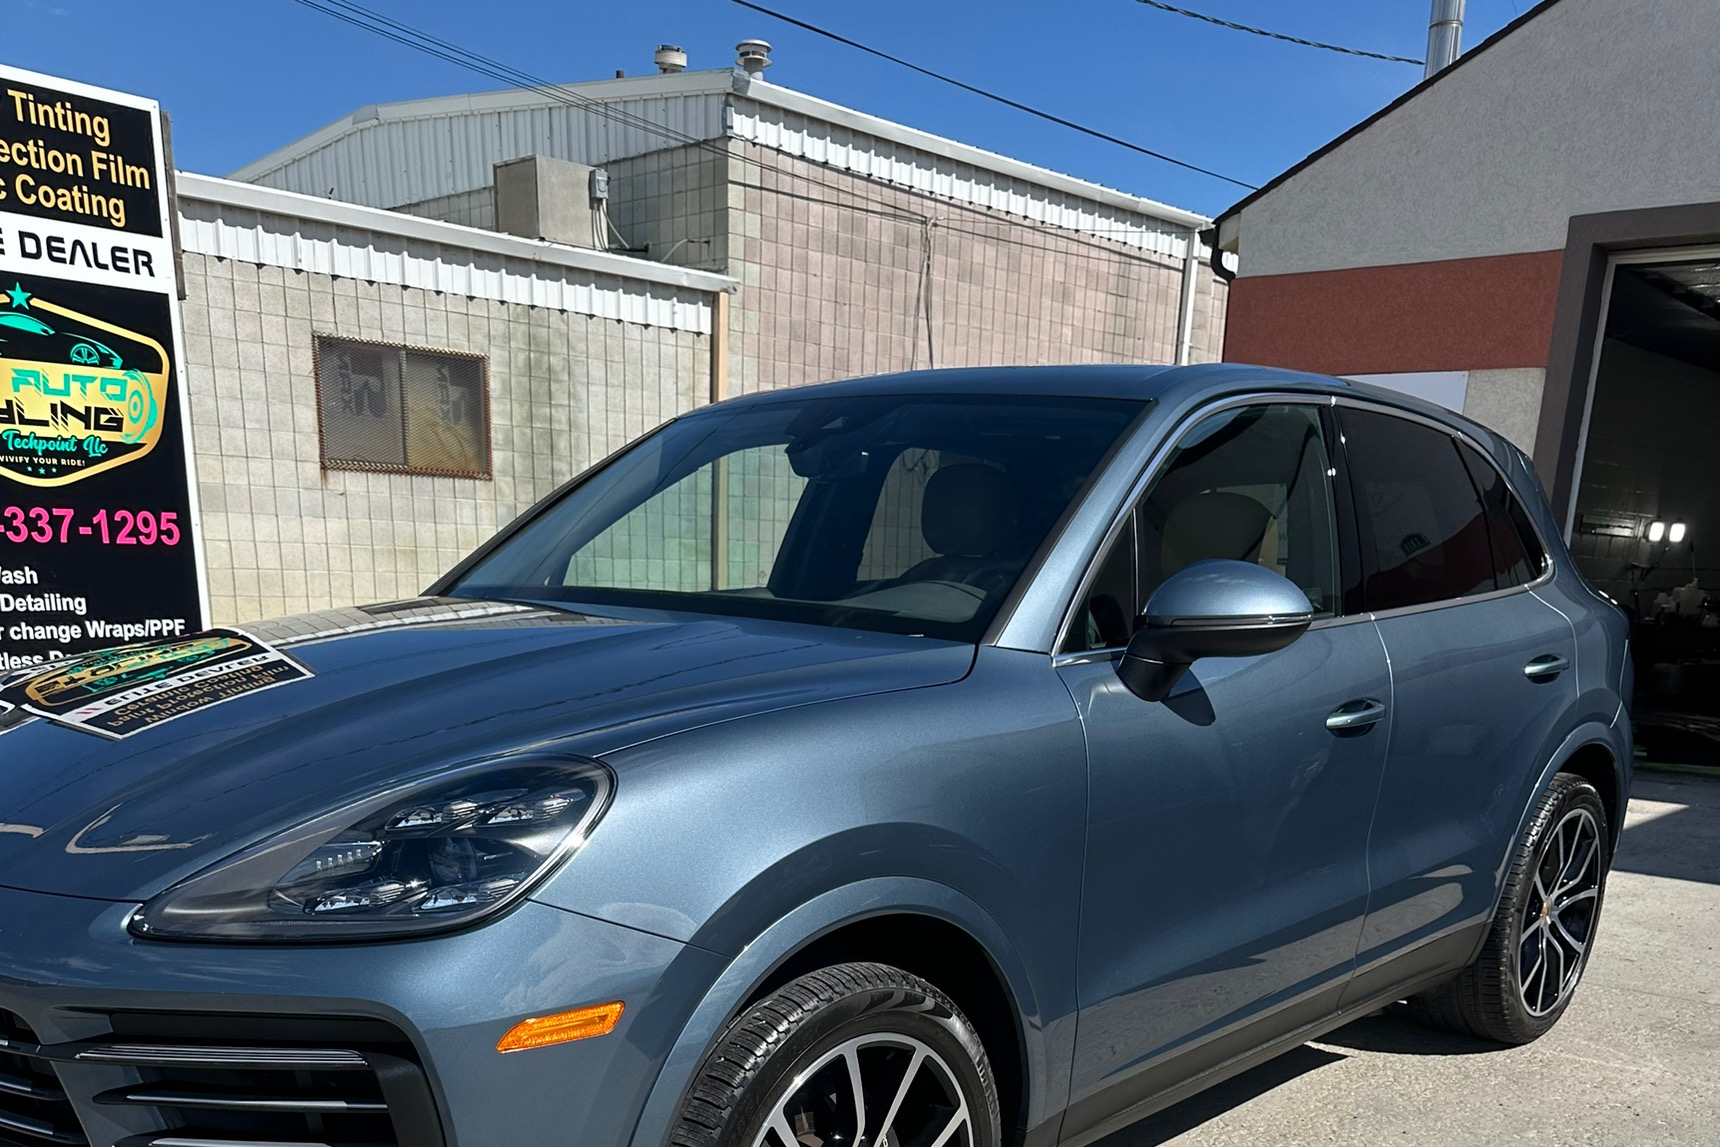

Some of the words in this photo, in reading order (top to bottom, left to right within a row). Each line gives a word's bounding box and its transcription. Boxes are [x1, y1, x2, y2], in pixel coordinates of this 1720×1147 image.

[8, 89, 110, 147] Tinting
[91, 150, 150, 190] Film
[15, 174, 126, 228] Coating
[18, 230, 155, 277] DEALER
[11, 368, 128, 402] AUTO
[2, 430, 77, 456] Techpoint
[33, 457, 58, 466] YOUR
[61, 459, 86, 467] RIDE!
[0, 566, 38, 585] ash
[0, 593, 87, 615] Detailing
[10, 622, 82, 643] change
[85, 619, 186, 641] Wraps/PPF
